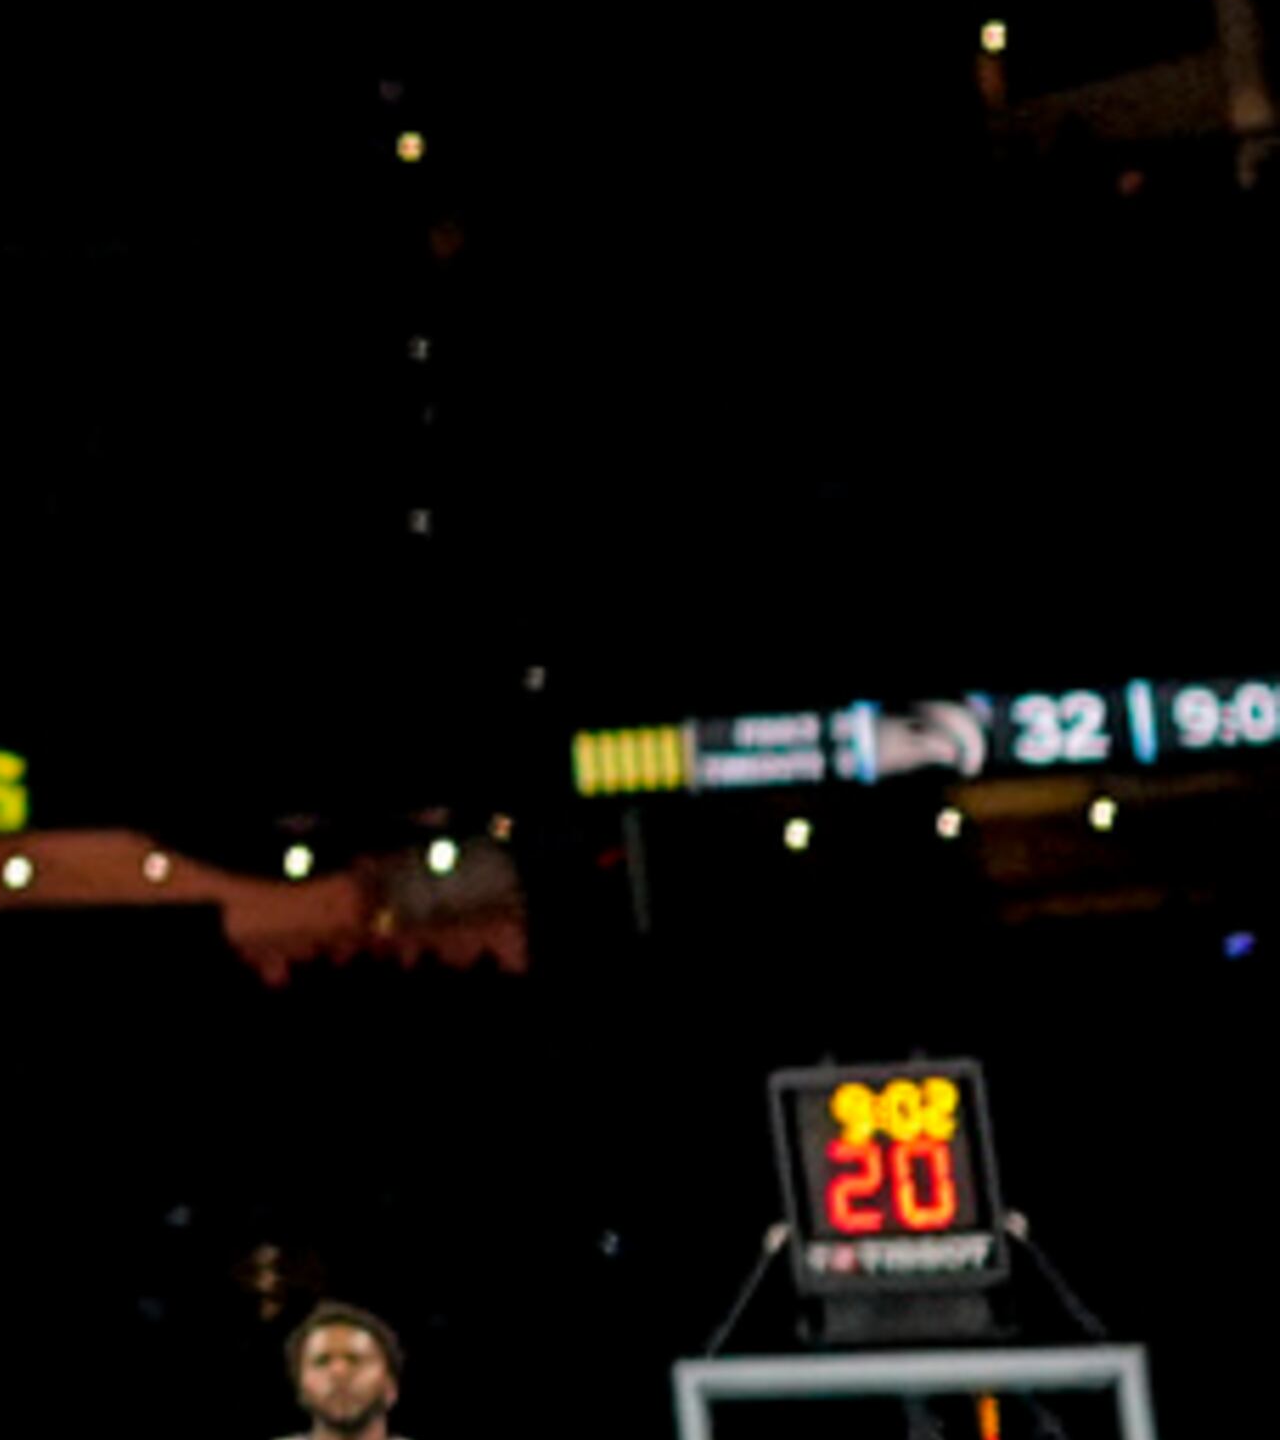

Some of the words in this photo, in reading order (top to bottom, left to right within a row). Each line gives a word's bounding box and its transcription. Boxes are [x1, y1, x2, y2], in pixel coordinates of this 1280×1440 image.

[1013, 689, 1111, 765] 32
[1173, 682, 1280, 748] 9:0
[830, 1075, 960, 1144] 9:02
[825, 1134, 957, 1234] 20
